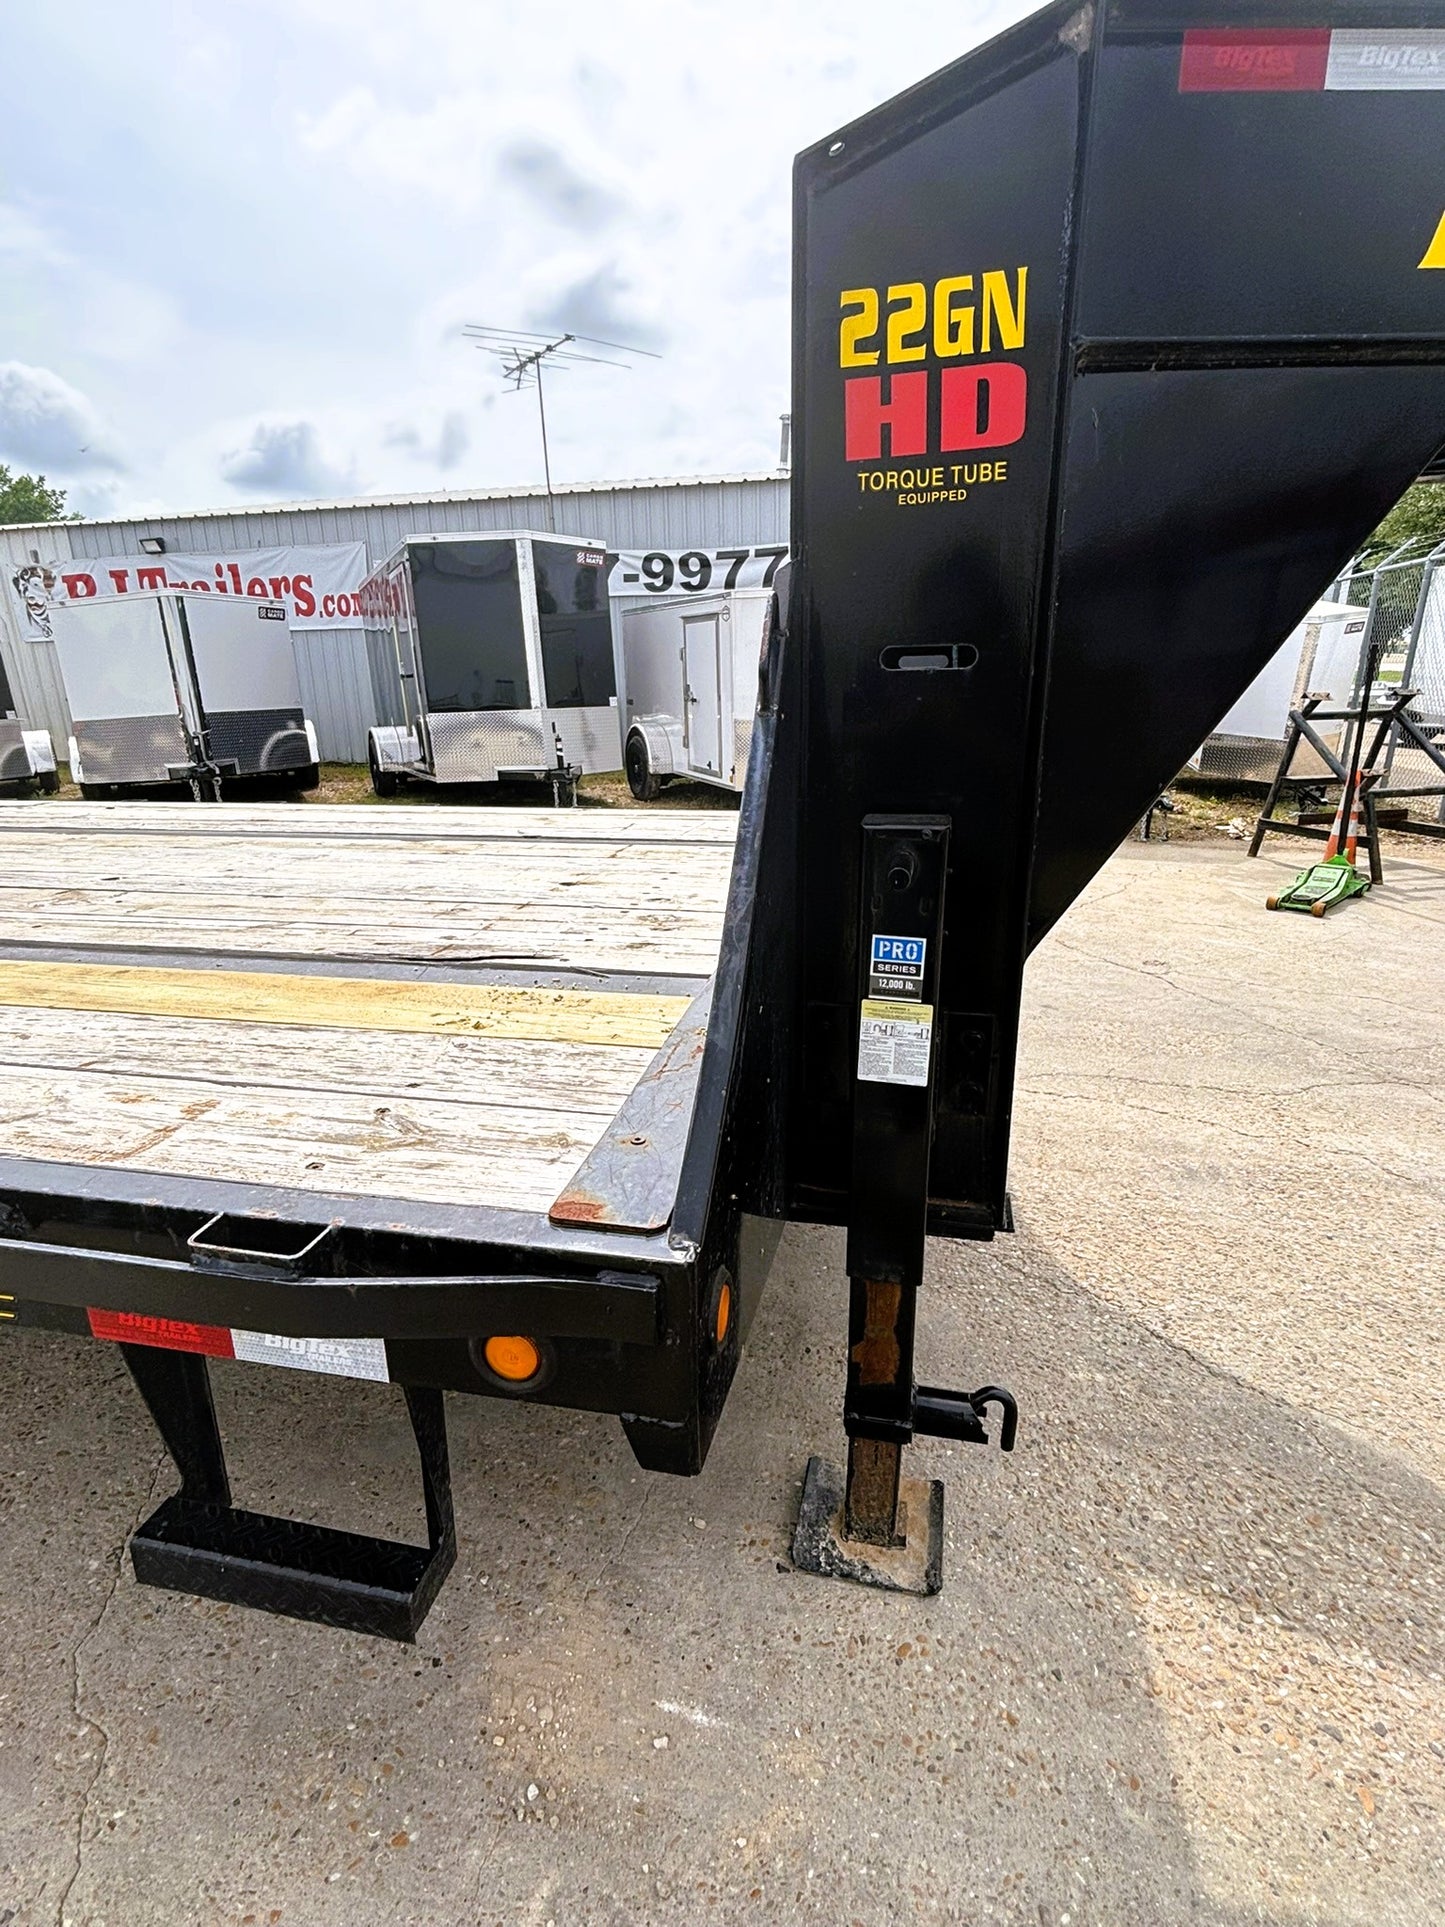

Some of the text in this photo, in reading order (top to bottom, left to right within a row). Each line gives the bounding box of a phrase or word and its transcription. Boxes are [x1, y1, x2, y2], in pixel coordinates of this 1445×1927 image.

[839, 266, 1028, 368] 22GN
[844, 362, 1028, 461] HD
[857, 461, 1008, 492] TORQUE TUBE
[898, 489, 967, 505] EQUIPPED
[879, 940, 918, 960] PRO
[877, 963, 917, 974] SERIES
[878, 978, 904, 989] 12,000
